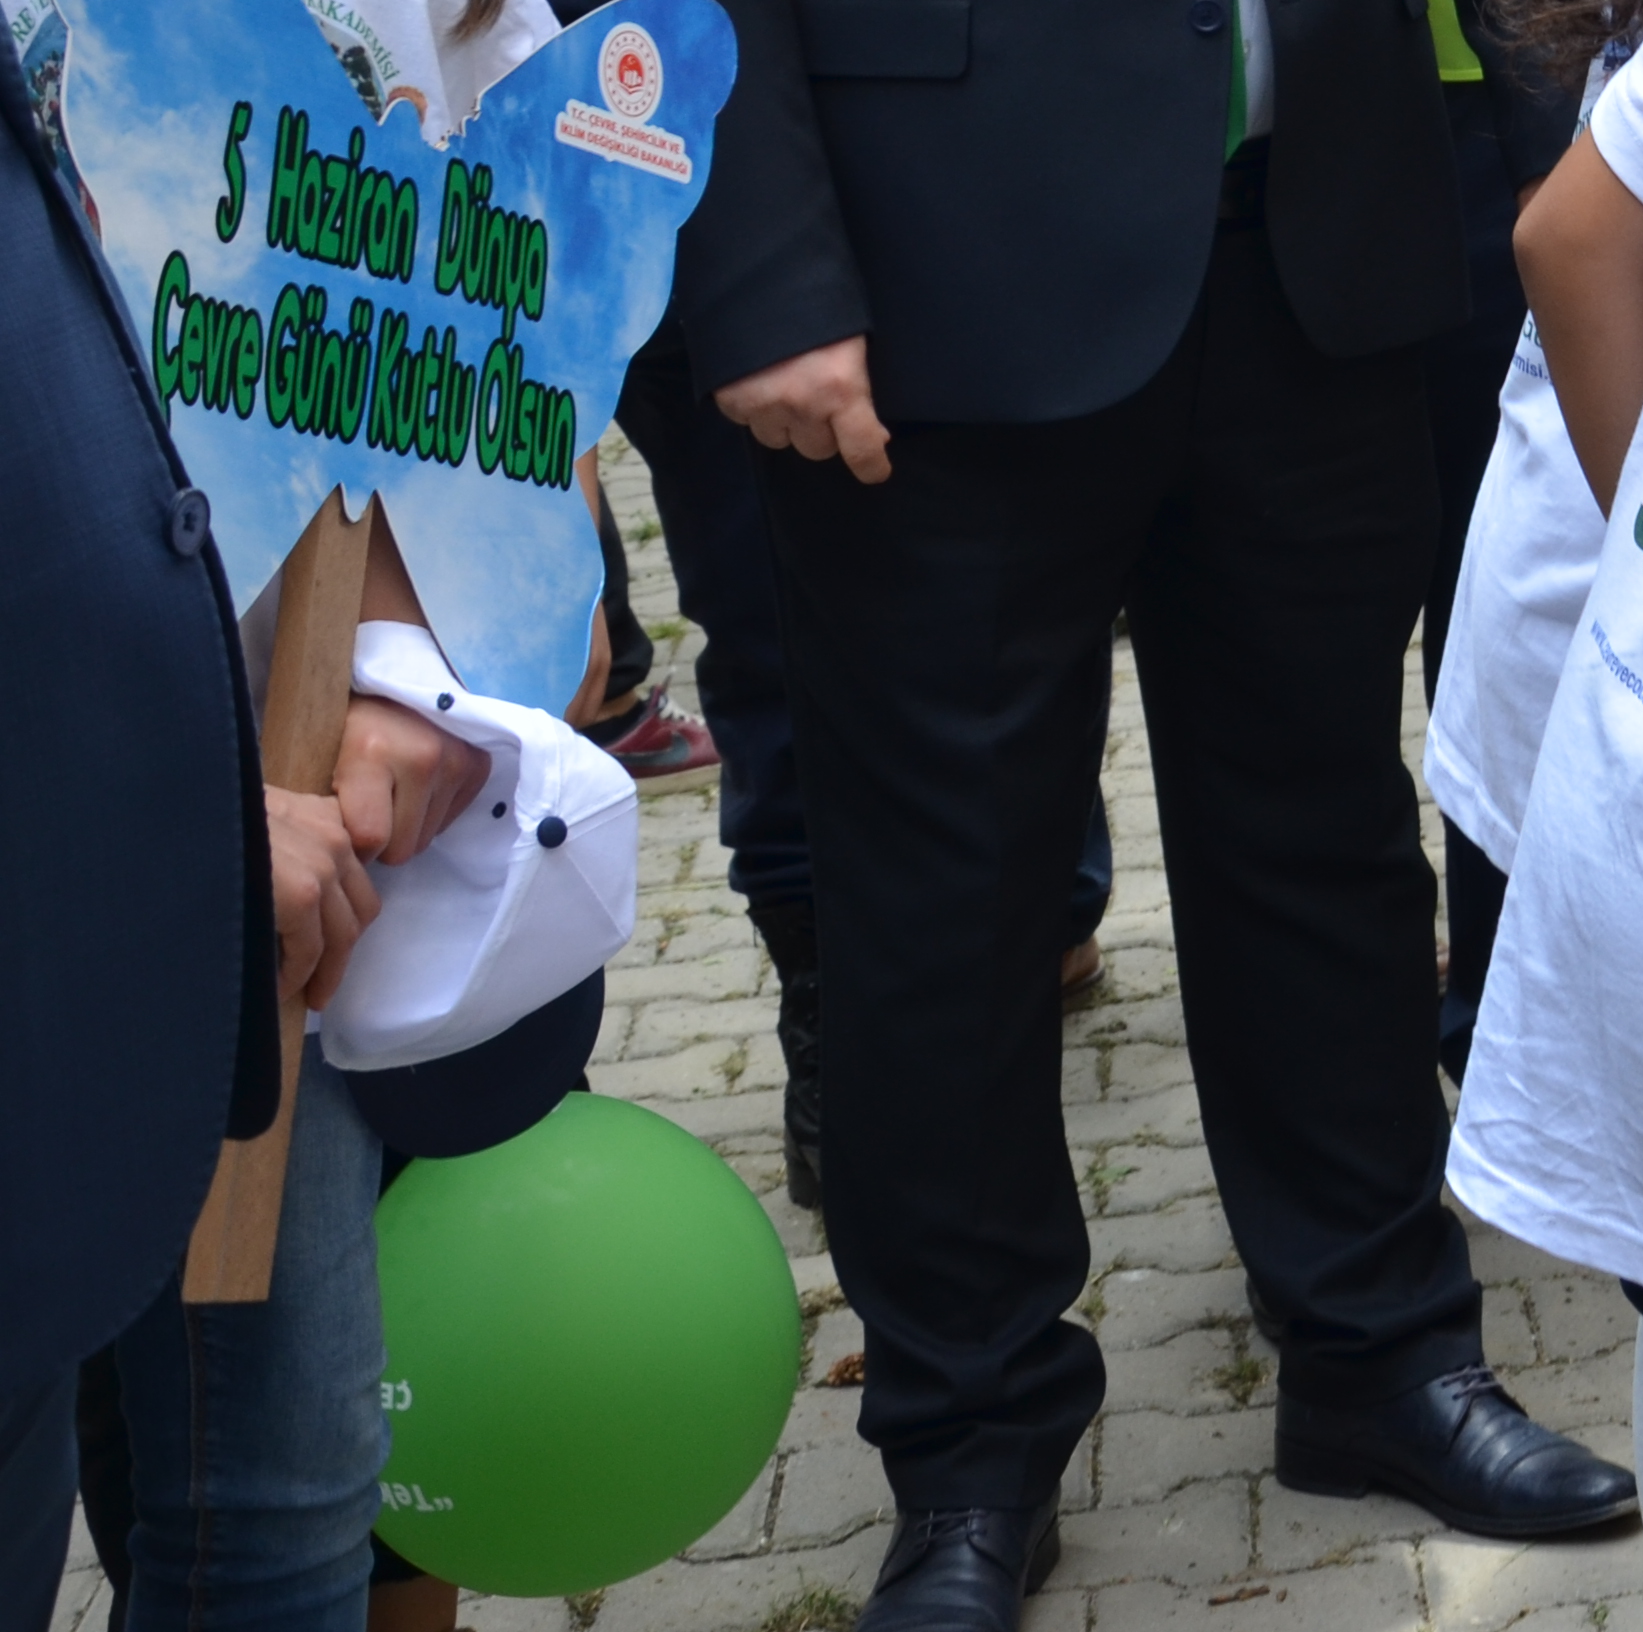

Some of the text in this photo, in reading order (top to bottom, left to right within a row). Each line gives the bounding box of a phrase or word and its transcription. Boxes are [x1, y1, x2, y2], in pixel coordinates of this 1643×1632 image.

[216, 101, 548, 342] 5 Haziran Dünya
[151, 249, 577, 491] Çevre Günü Kutlu Olsun
